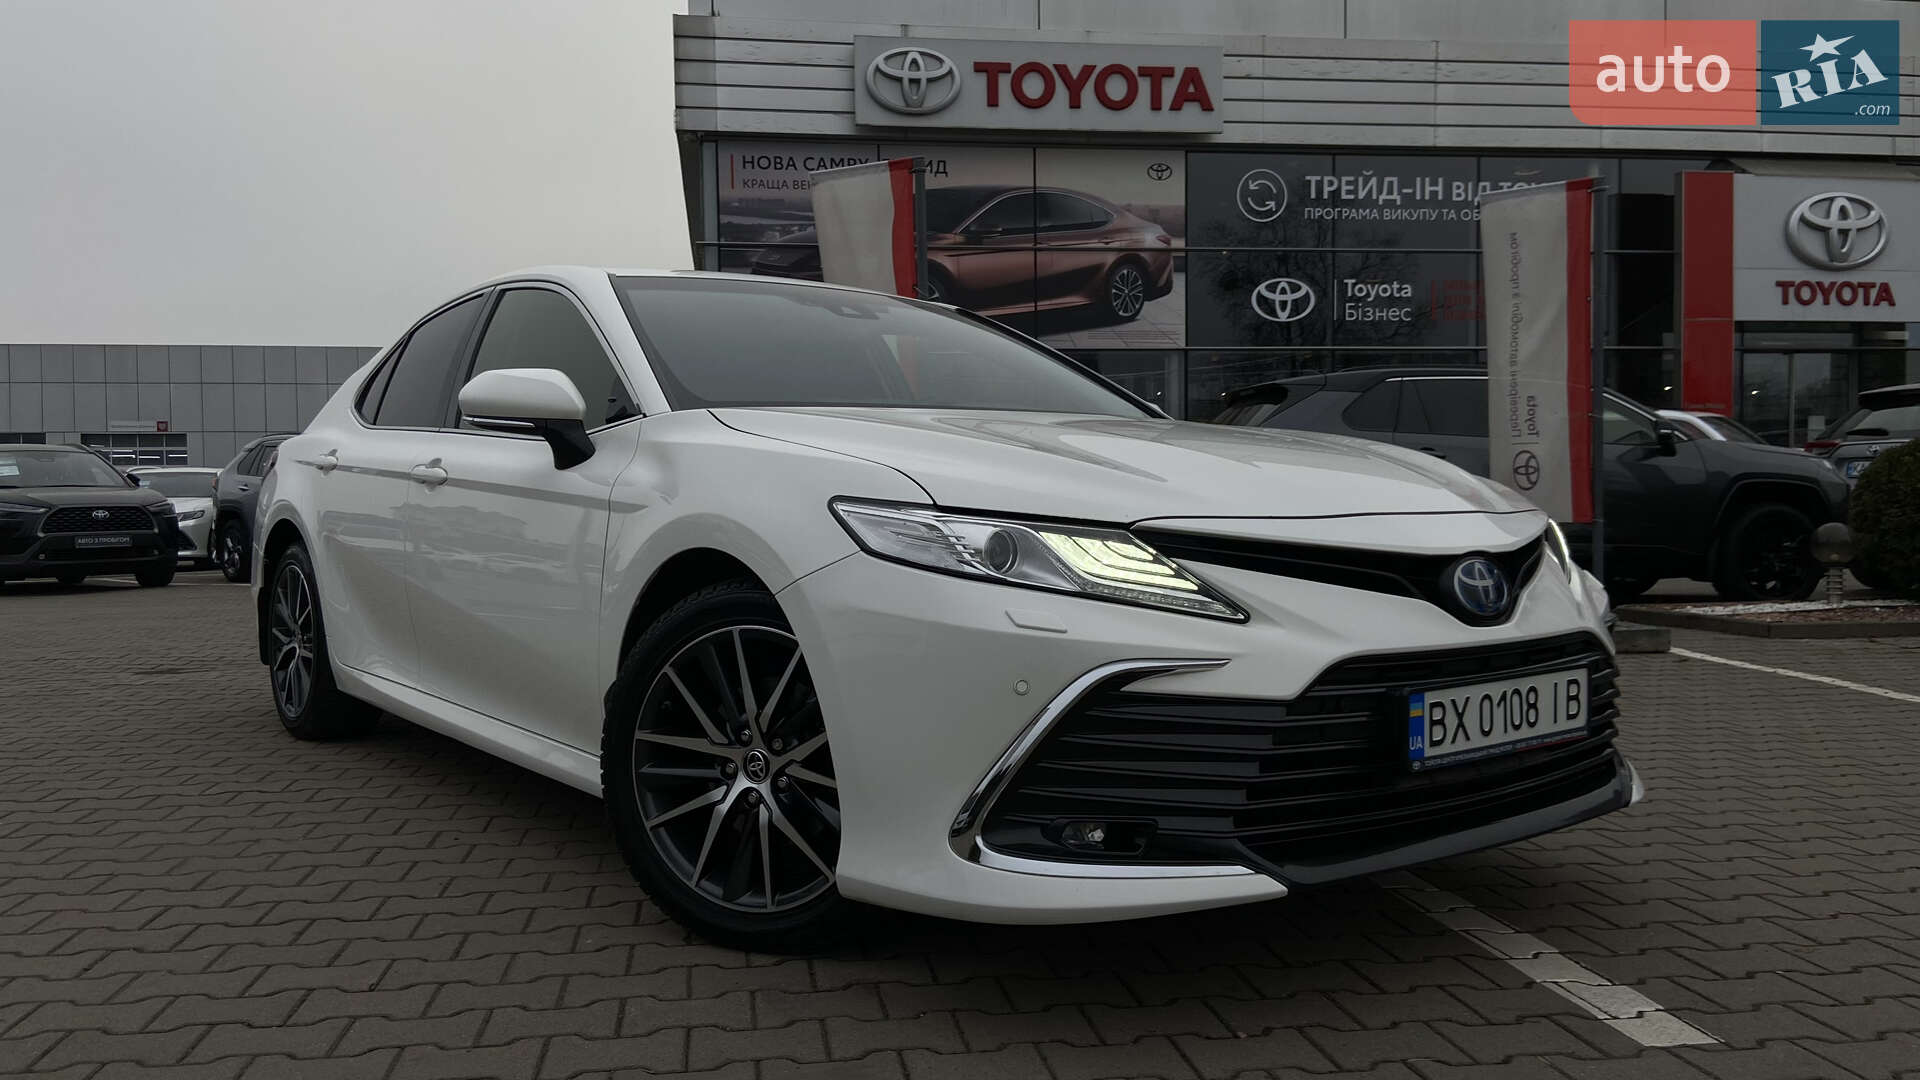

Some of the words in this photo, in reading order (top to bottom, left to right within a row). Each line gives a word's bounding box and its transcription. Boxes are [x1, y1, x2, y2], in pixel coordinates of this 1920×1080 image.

[974, 62, 1215, 112] TOYOTA
[742, 155, 795, 171] НОВА
[743, 178, 788, 191] КРАЩА
[1305, 170, 1444, 205] ТРЕЙД-ІН
[1304, 207, 1380, 221] ПРОГРАМА
[1383, 208, 1438, 221] ВИКУПУ
[1441, 208, 1457, 221] ТА
[1344, 279, 1412, 301] Toyota
[1776, 280, 1896, 307] TOYOTA
[1345, 303, 1412, 321] Бізнес
[1429, 696, 1471, 748] BX
[1479, 685, 1539, 737] 0108
[1553, 678, 1581, 724] IB
[1409, 736, 1424, 751] UA
